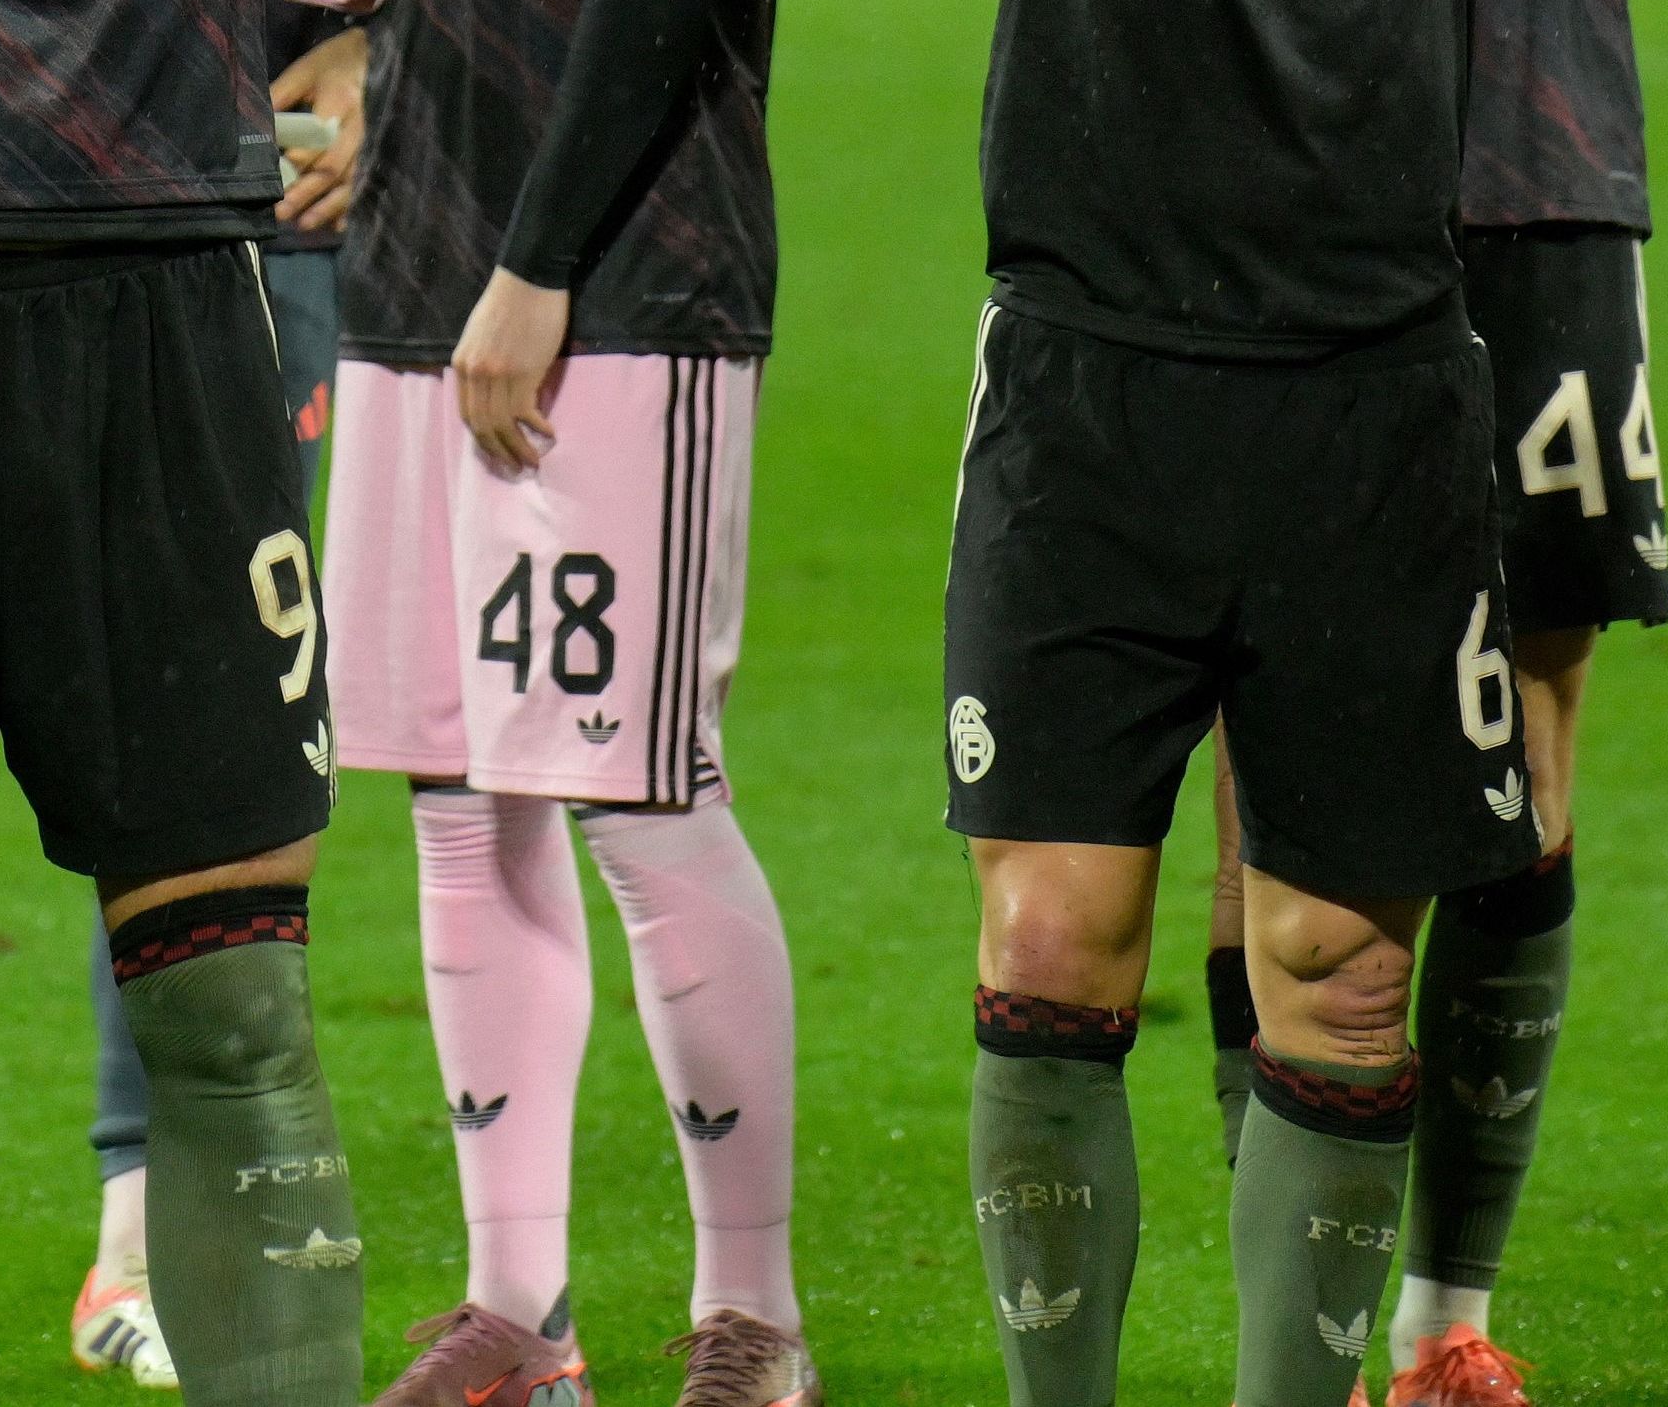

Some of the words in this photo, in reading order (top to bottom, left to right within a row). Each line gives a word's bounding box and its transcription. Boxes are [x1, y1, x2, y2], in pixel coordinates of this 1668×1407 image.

[1517, 362, 1667, 518] 44
[248, 529, 317, 704] 9
[479, 552, 616, 695] 48
[1456, 591, 1512, 750] 6
[976, 1182, 1092, 1223] FCBM
